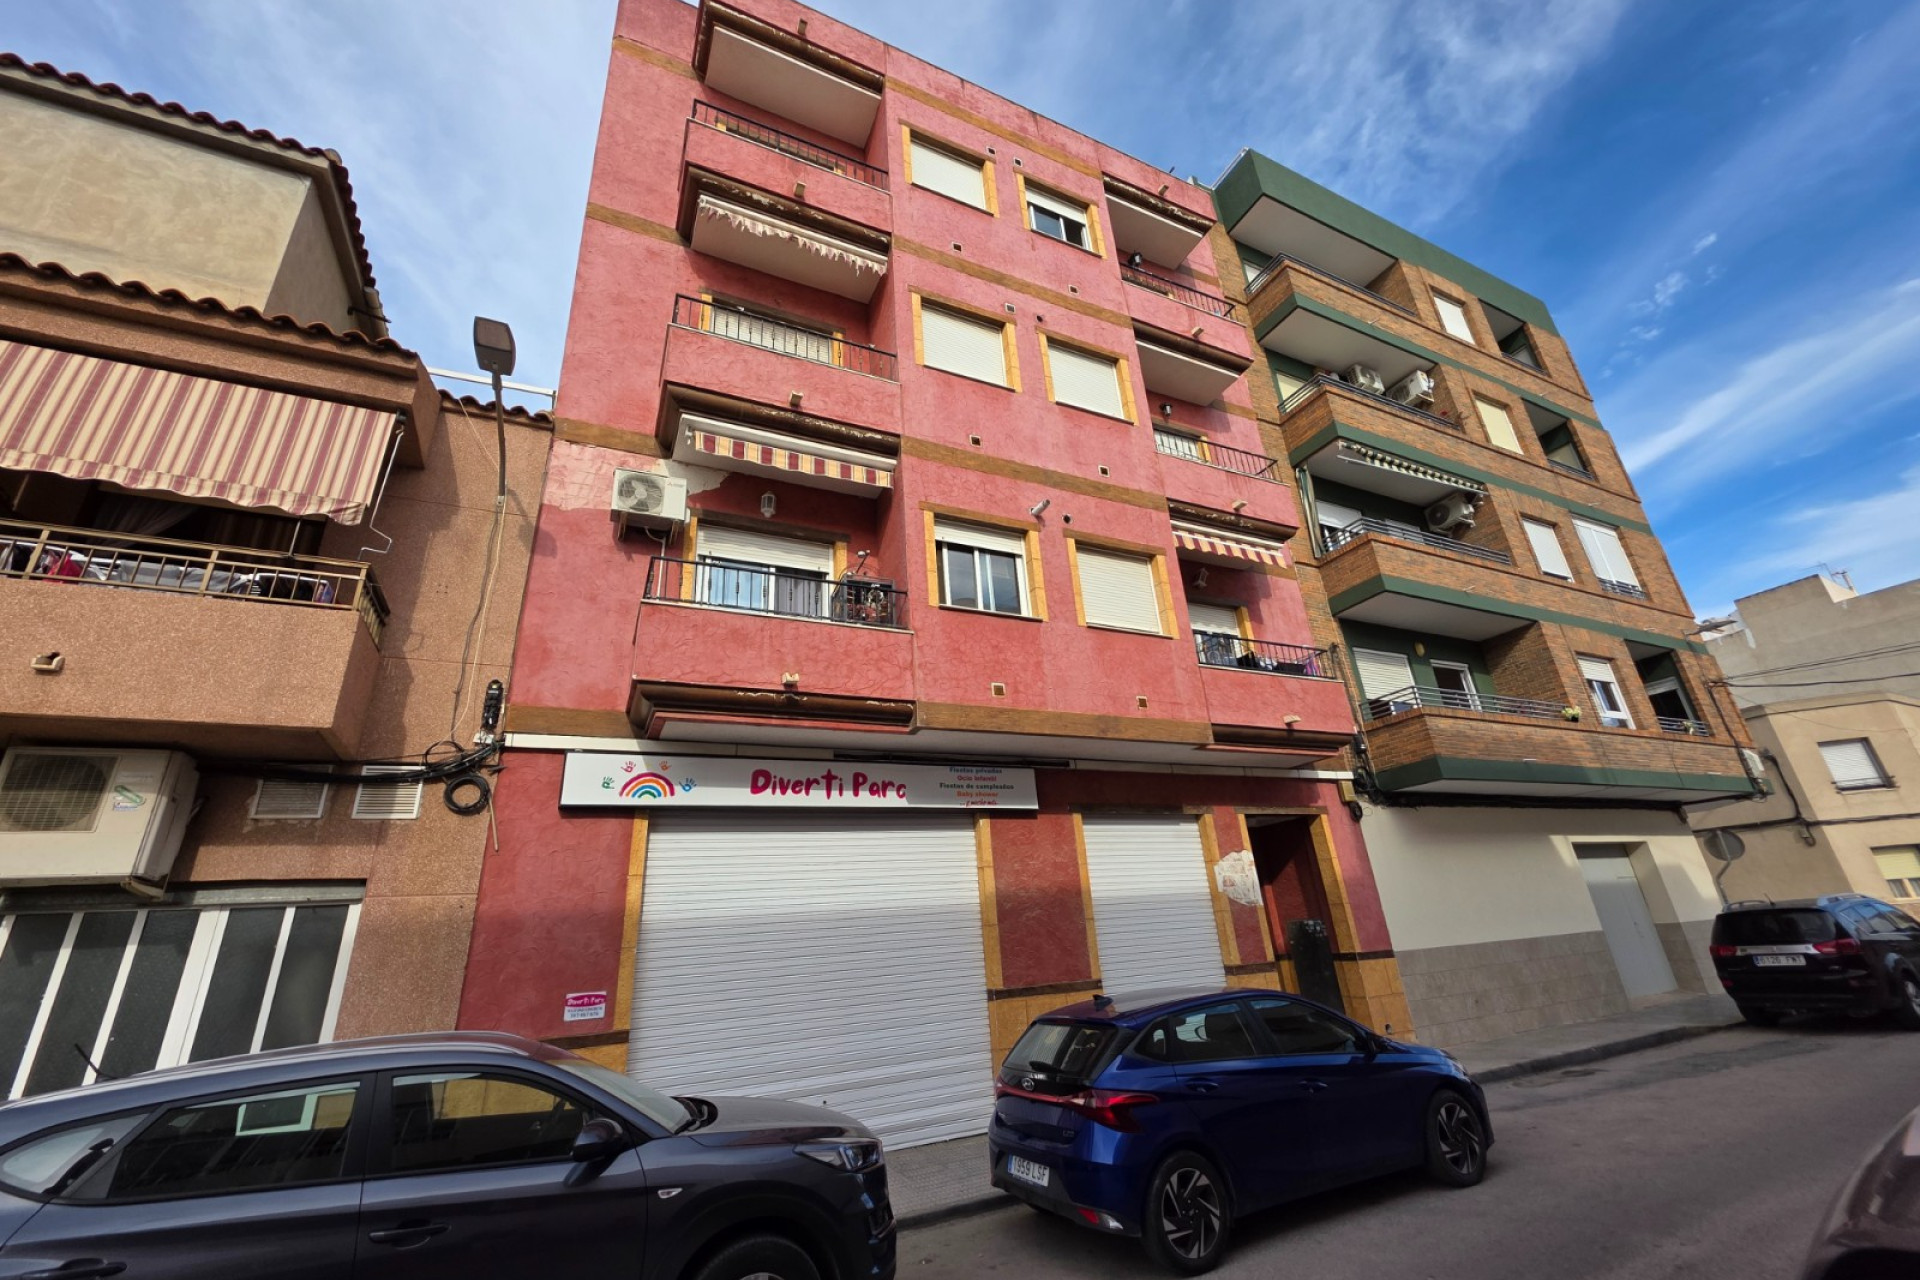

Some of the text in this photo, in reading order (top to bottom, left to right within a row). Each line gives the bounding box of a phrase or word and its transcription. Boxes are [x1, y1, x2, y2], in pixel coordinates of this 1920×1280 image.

[949, 766, 1003, 775] Fiestas privadas
[750, 768, 907, 800] Diverti Parc
[939, 782, 964, 790] Fiestas
[956, 790, 974, 798] Baby
[1013, 1156, 1031, 1176] 1959
